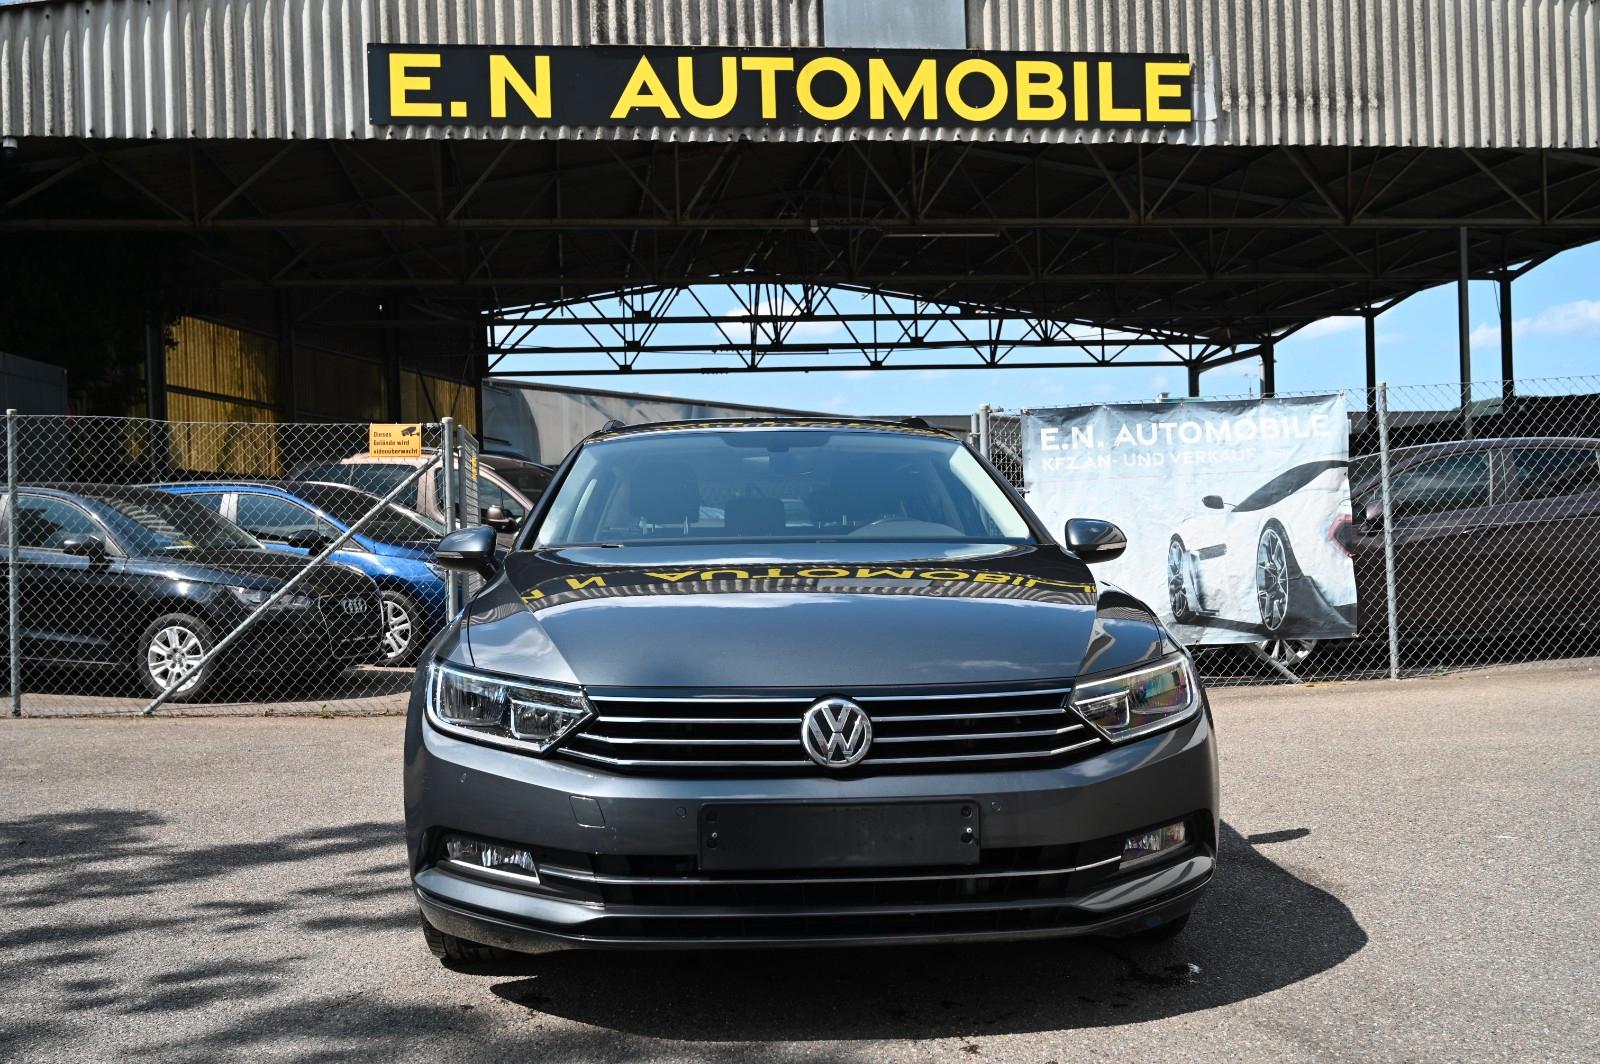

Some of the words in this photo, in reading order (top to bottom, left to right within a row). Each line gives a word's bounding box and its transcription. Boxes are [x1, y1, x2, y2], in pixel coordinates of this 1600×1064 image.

[610, 56, 1193, 123] AUTOMOBILE
[1040, 426, 1104, 451] E.N.
[1113, 414, 1331, 447] AUTOMOBILE
[1123, 451, 1165, 467] UND
[1169, 447, 1257, 465] VERKAUF
